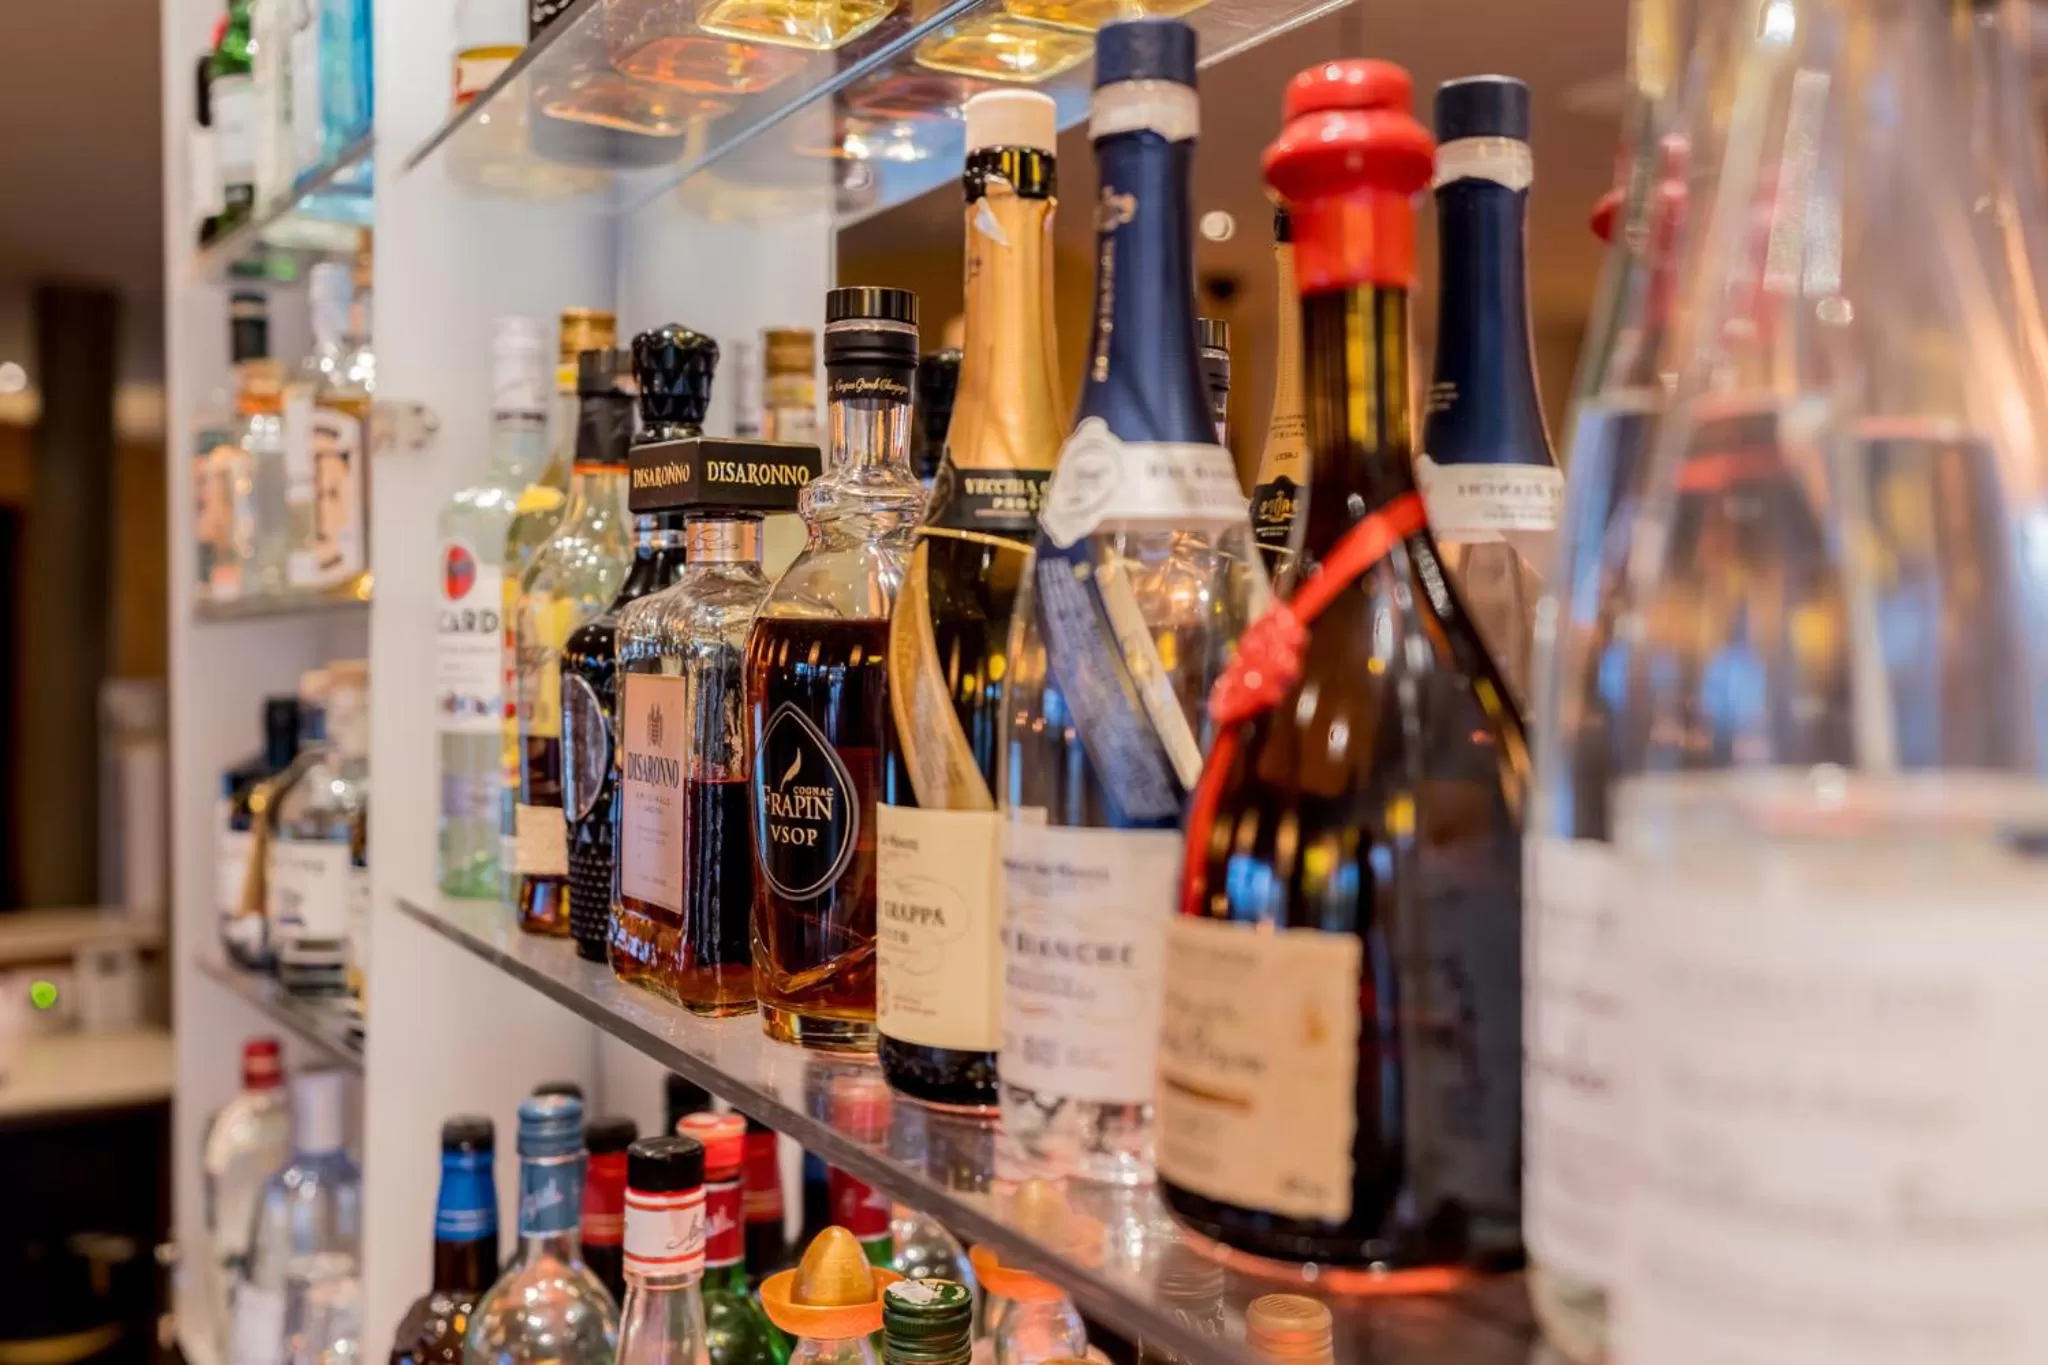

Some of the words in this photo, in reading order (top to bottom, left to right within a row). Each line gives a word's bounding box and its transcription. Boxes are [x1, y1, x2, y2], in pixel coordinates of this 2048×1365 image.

[632, 460, 691, 489] DISARONNO
[706, 460, 810, 487] DISARONNO
[627, 751, 680, 790] DISARONNO
[761, 784, 835, 821] FRAPIN
[792, 785, 835, 797] COGNAC
[770, 823, 819, 847] VSOP
